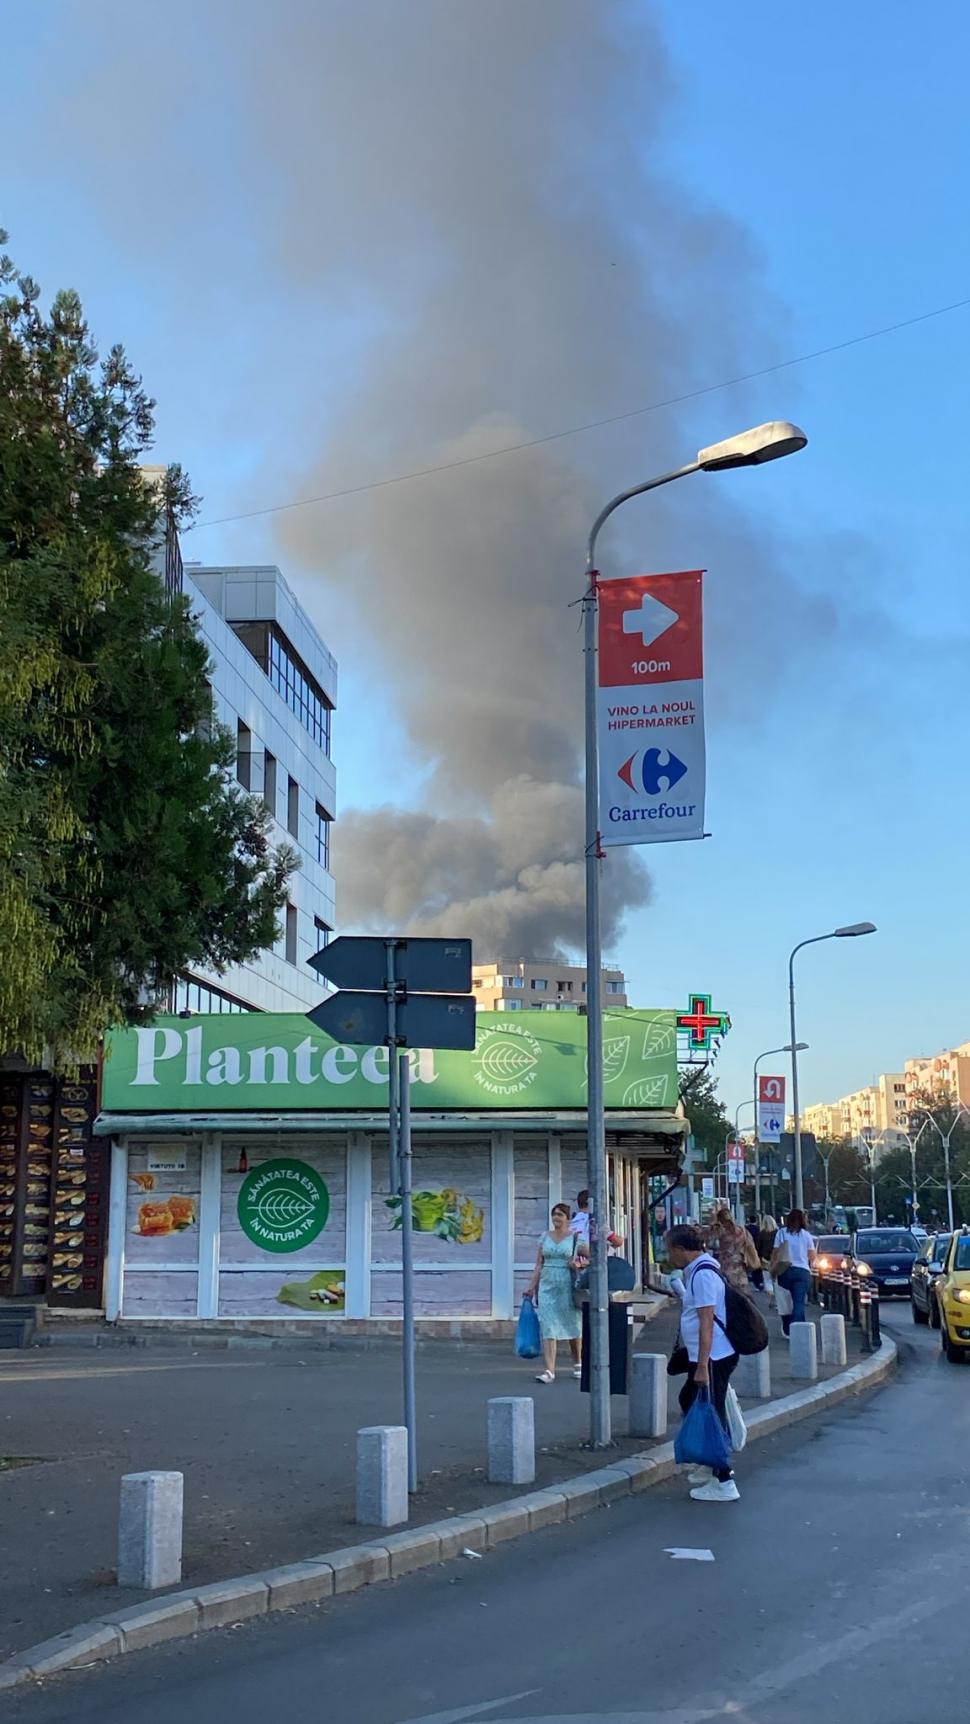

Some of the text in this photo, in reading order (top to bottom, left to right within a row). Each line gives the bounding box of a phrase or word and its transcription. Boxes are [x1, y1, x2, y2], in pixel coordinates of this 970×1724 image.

[631, 660, 671, 674] 100m
[607, 700, 696, 717] VINO LA NOUL
[608, 714, 696, 731] HIPERMARKET
[609, 802, 696, 822] Carrefour
[523, 1030, 543, 1055] ESTE
[128, 1025, 440, 1085] Planteea
[483, 1081, 527, 1095] NATURA
[523, 1072, 538, 1084] TA
[300, 1176, 320, 1202] ESTE
[259, 1227, 304, 1241] NATURA
[300, 1218, 315, 1230] TA
